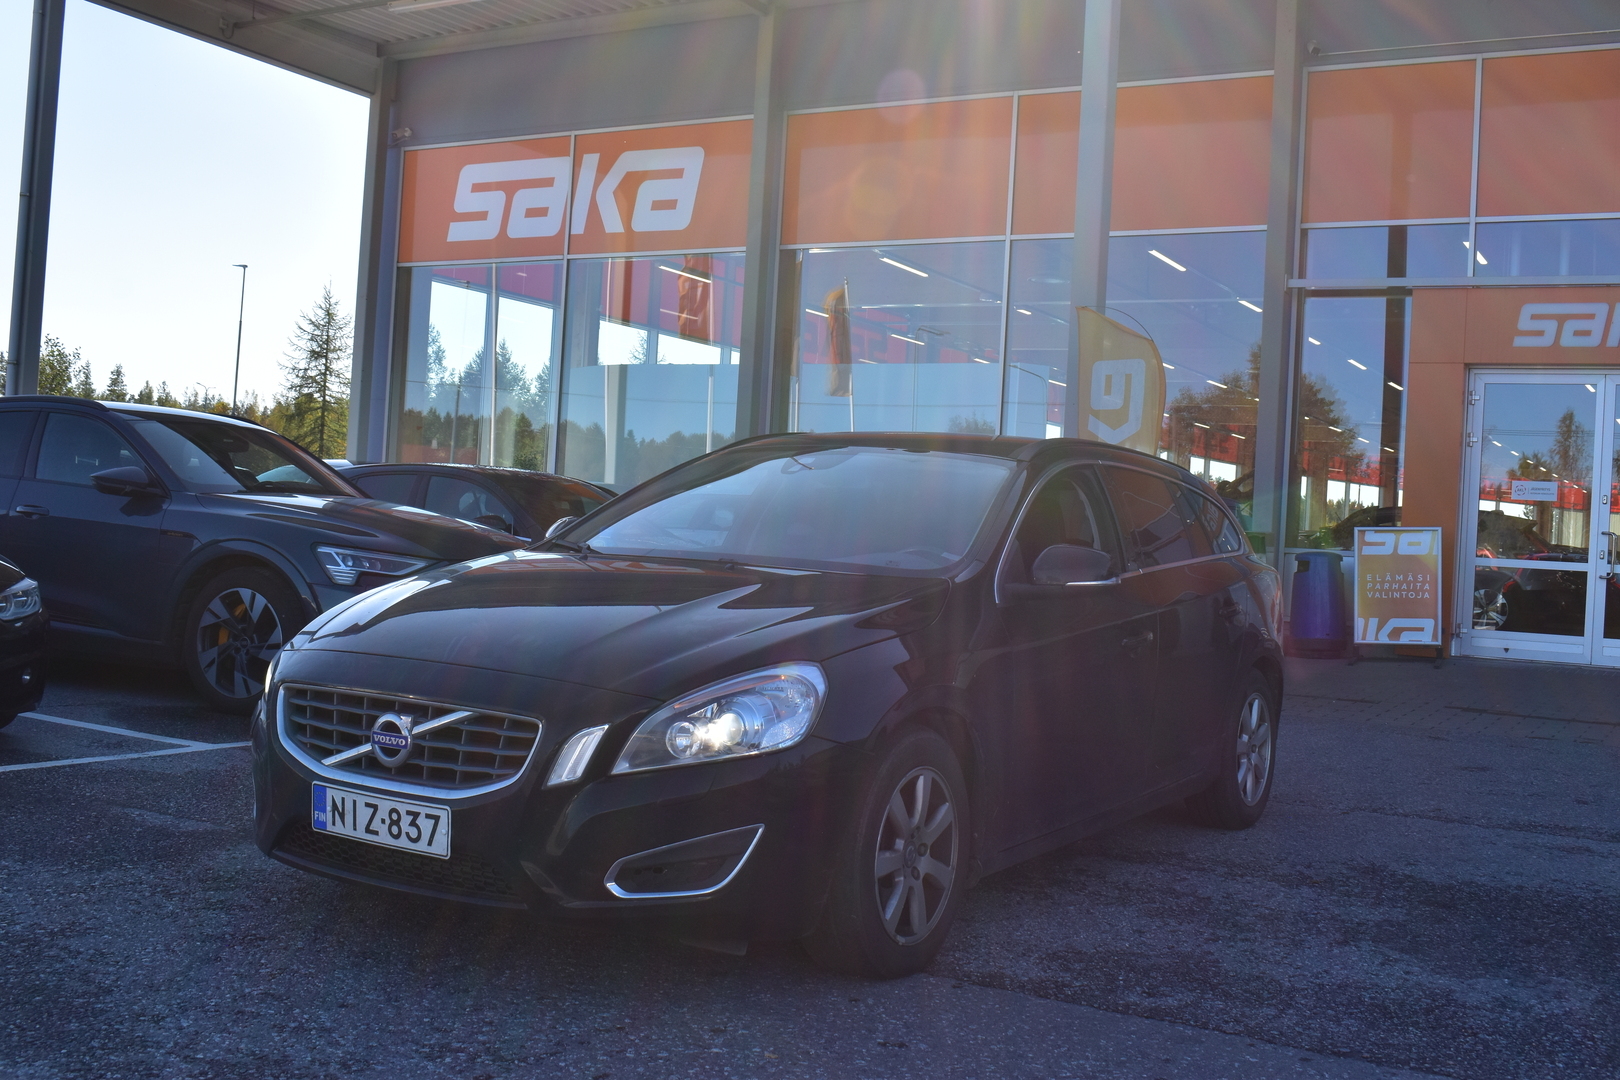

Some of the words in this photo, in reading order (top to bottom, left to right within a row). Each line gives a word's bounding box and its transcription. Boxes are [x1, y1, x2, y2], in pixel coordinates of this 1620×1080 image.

[1512, 302, 1620, 348] sa
[1361, 531, 1438, 555] sa
[1366, 572, 1430, 581] ELÄMÄSI
[1366, 582, 1430, 590] PARHAITA
[1366, 591, 1430, 599] VALINTOJA
[373, 734, 406, 746] VOLVO
[314, 810, 326, 823] FIN
[331, 795, 441, 847] NIZ-837
